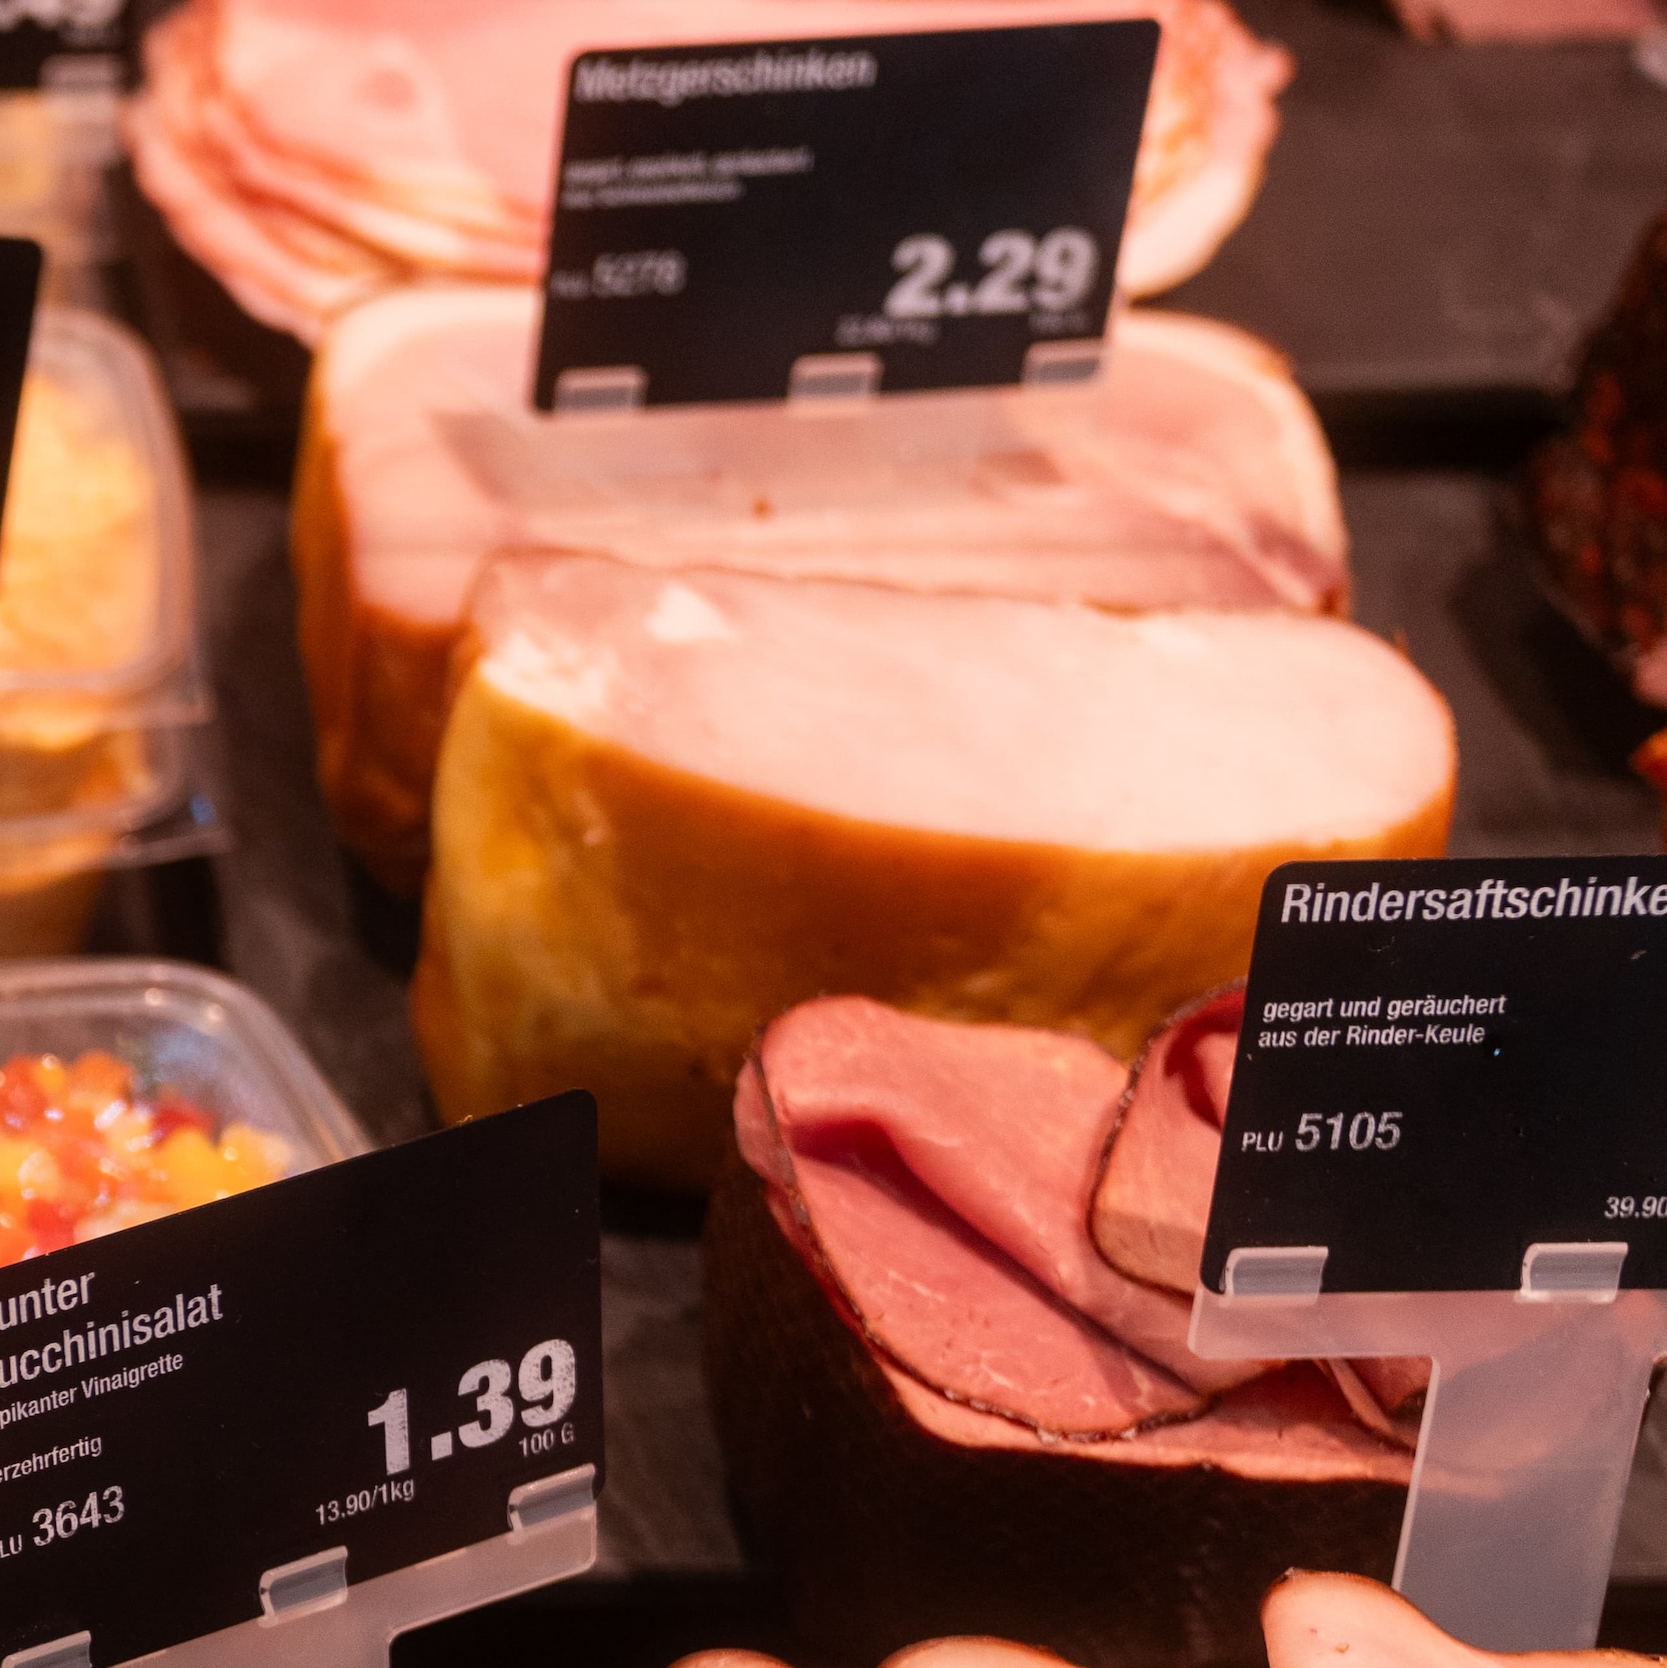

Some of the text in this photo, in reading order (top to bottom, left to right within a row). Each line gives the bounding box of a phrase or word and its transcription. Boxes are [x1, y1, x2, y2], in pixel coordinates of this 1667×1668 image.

[575, 48, 876, 107] Metzgerschinken
[883, 229, 1098, 318] 2.29
[1280, 876, 1667, 924] Rindersaftschinke
[1263, 994, 1507, 1023] gegart und geräuchert
[1258, 1023, 1486, 1047] aus der Rinder-Keule
[1241, 1111, 1403, 1152] PLU 5105
[0, 1385, 77, 1433] pikanter
[81, 1351, 184, 1401] Vinaigrette
[367, 1338, 577, 1478] 1.39
[519, 1423, 575, 1459] 100 G
[32, 1484, 126, 1550] 3643
[314, 1477, 415, 1527] 13.90/1kg
